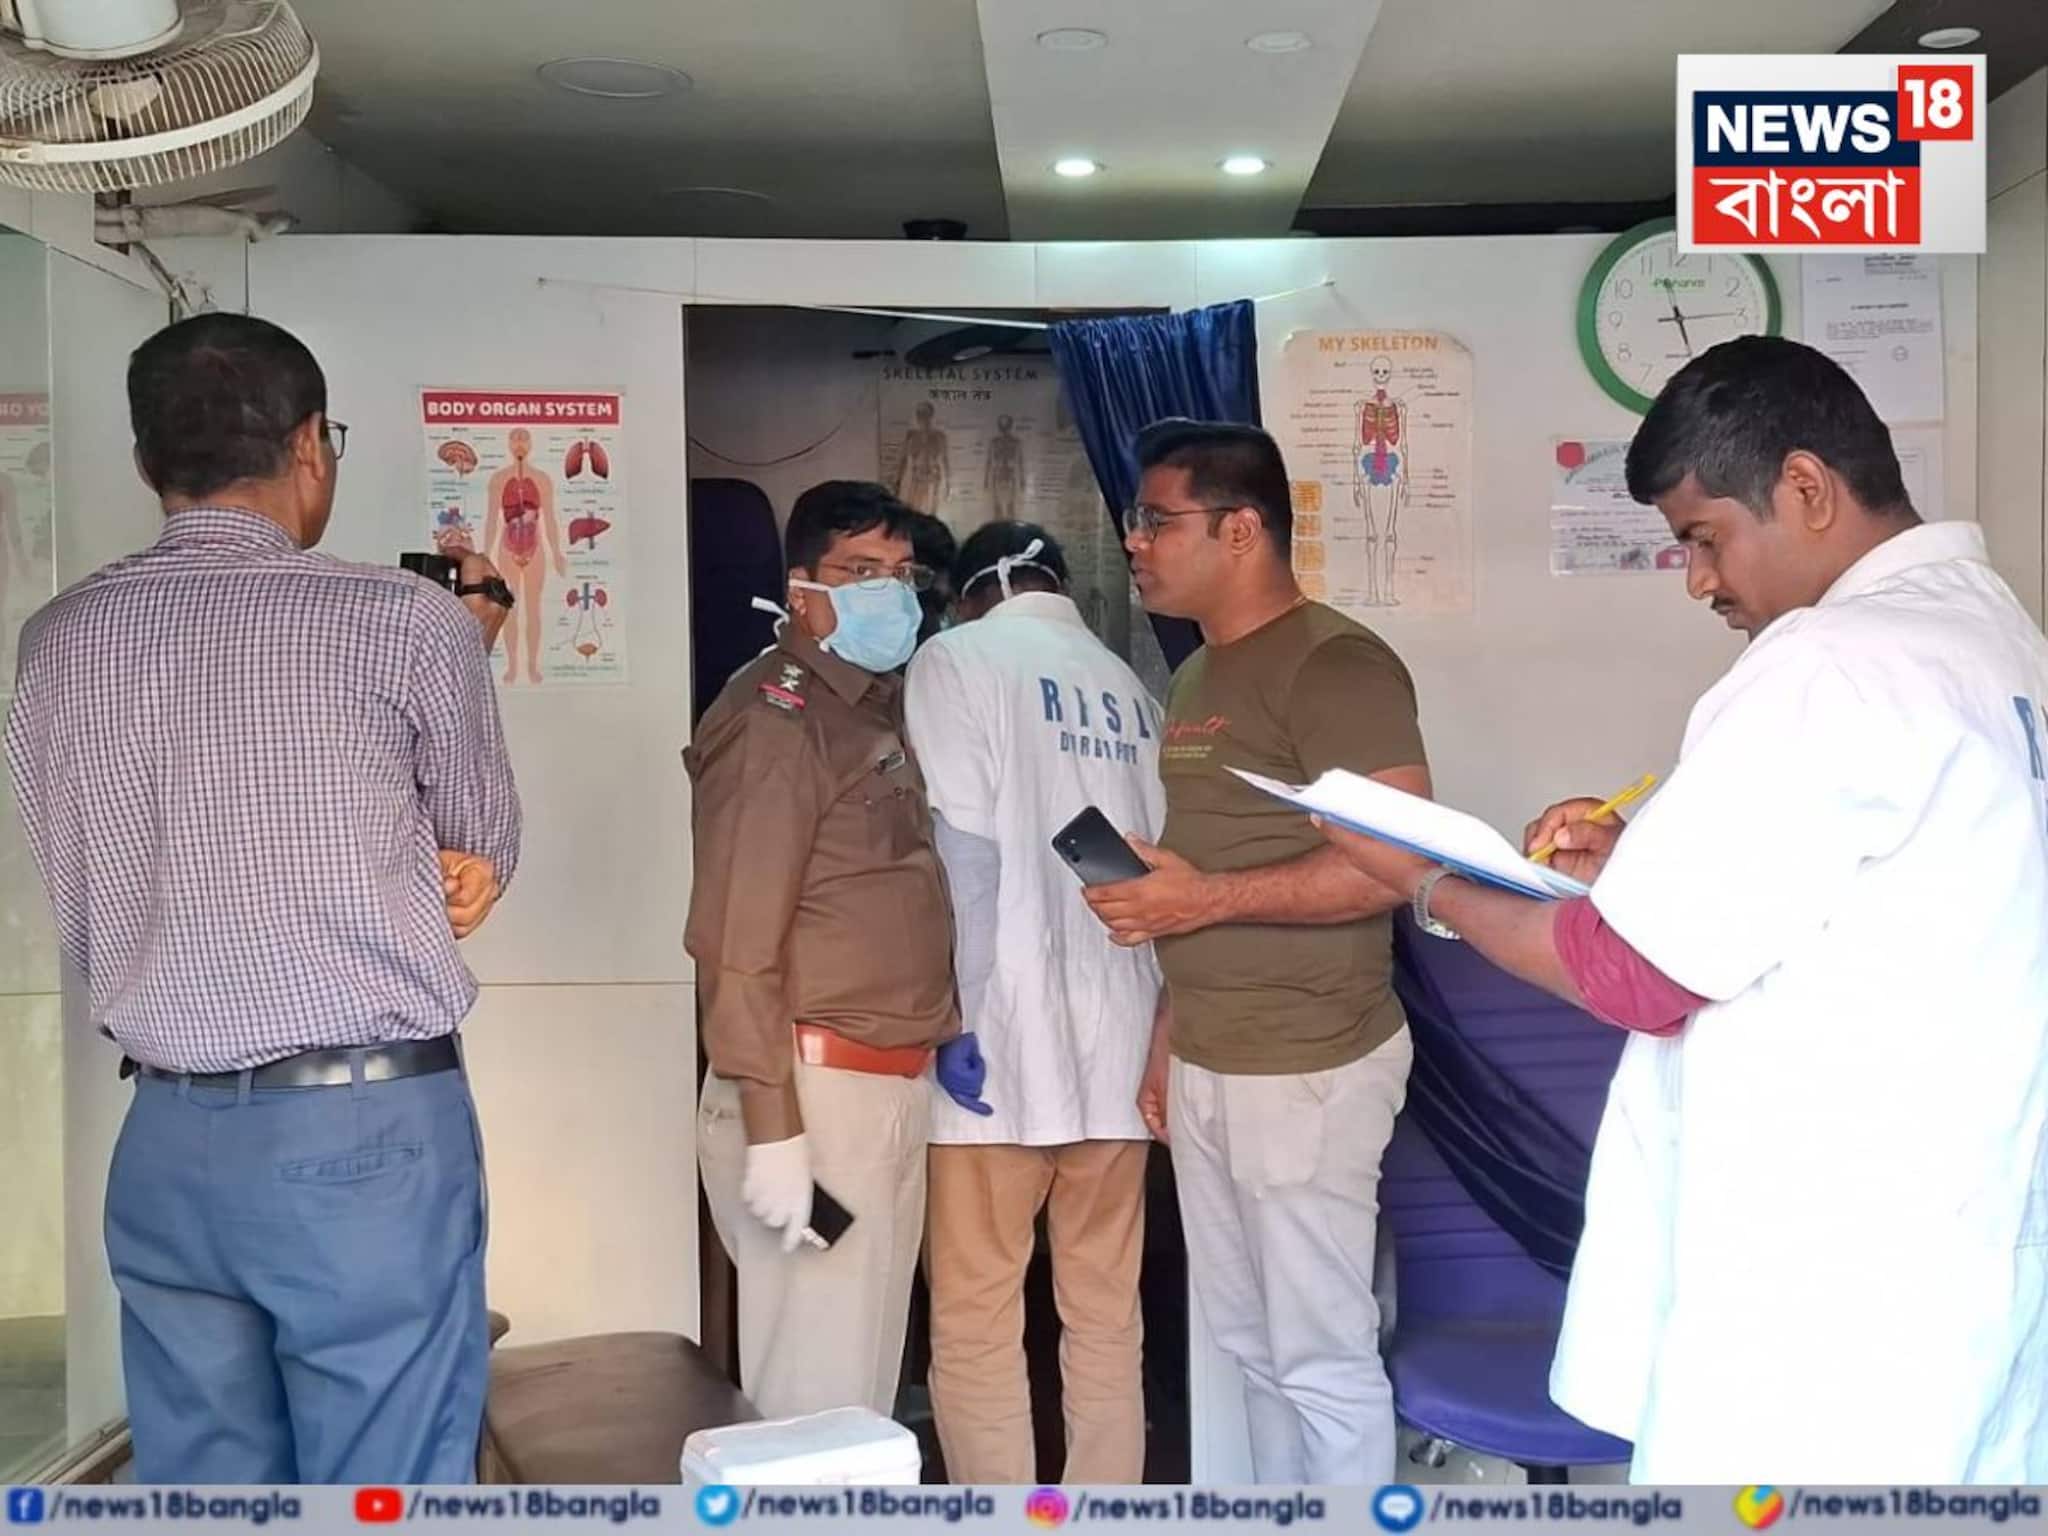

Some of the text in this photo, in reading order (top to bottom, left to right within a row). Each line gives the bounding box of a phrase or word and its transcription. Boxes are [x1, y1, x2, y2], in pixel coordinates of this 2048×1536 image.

[1318, 335, 1439, 351] MY SKELETON
[882, 366, 1038, 381] SKELETAL SYSTEM
[427, 401, 613, 417] BODY ORGAN SYSTEM
